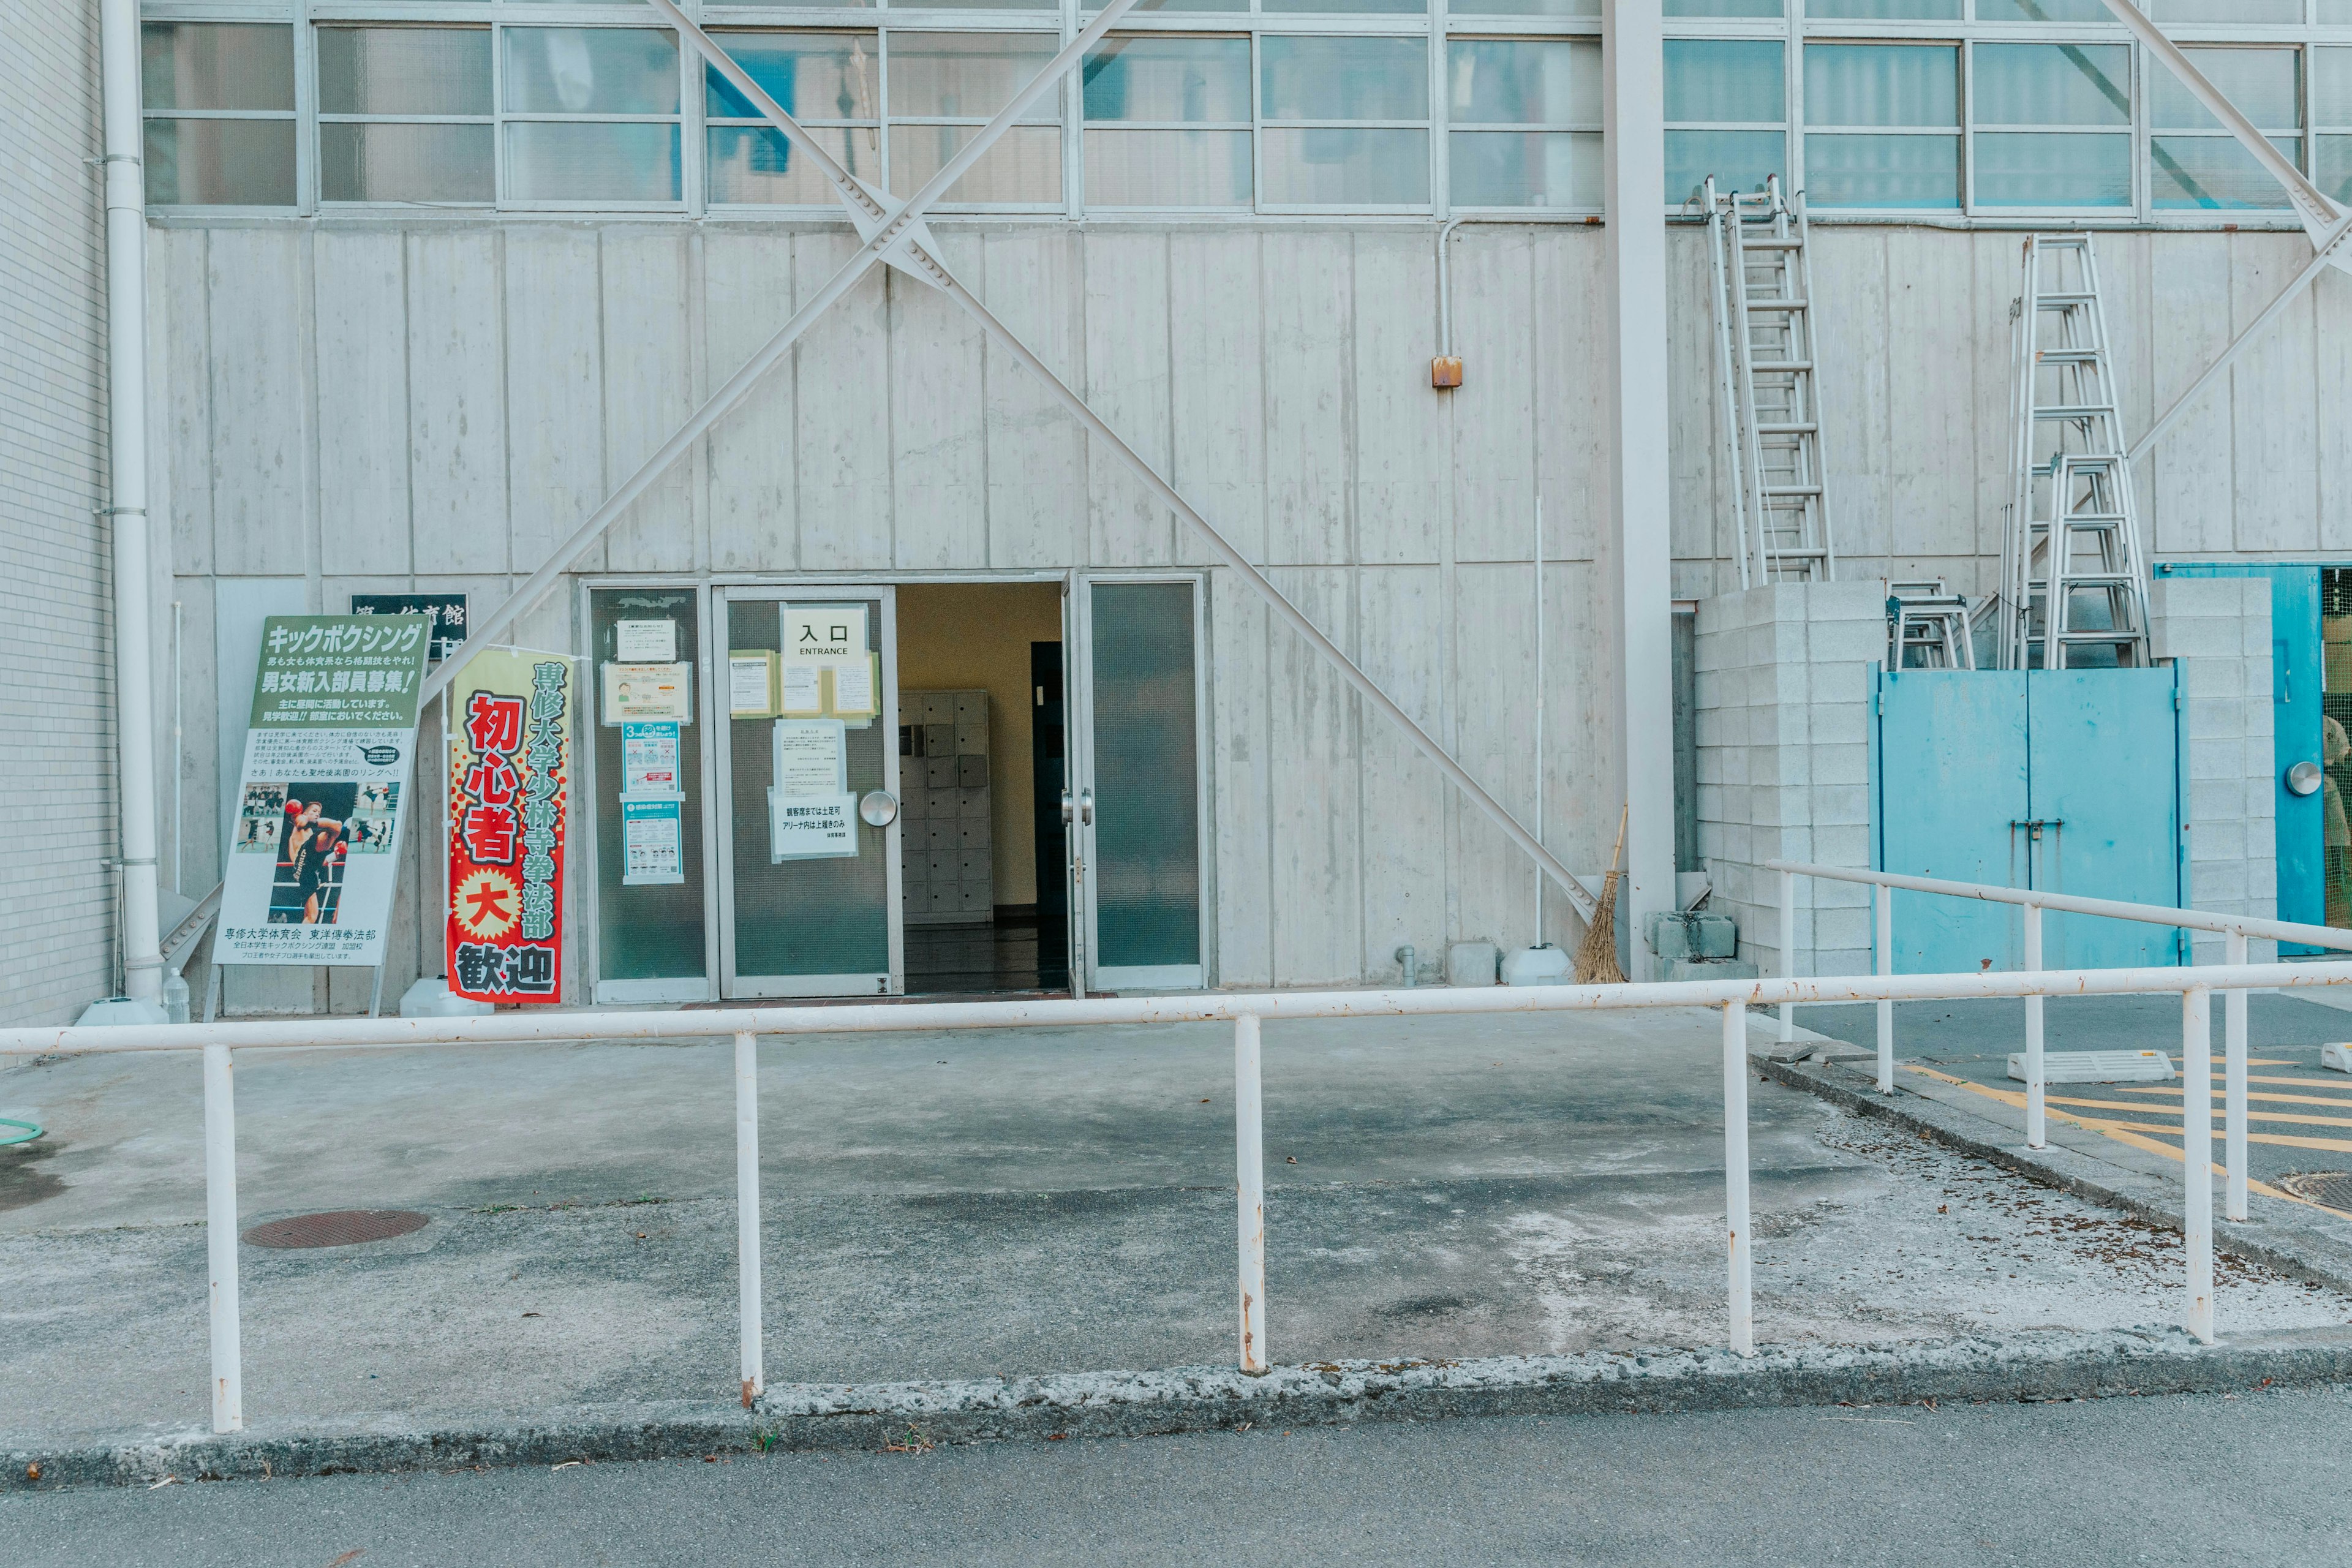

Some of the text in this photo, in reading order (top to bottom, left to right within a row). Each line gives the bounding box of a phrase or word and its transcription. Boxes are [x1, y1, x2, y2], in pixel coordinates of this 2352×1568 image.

[268, 624, 423, 654] キックボクシング
[799, 625, 847, 642] 入口
[262, 670, 415, 694] 男女新入部員募集!
[278, 699, 390, 709] 主に昼間に活動しています。
[466, 694, 522, 861] 初心者
[522, 663, 565, 939] 専修大学少林寺拳法部
[786, 806, 840, 816] 観客席までは土足可
[783, 820, 845, 830] アリーナ内は上履きのみ
[466, 882, 512, 927] 大
[225, 928, 376, 941] 専修大学体育会 東洋傳拳法部
[233, 941, 336, 950] 全日本学生キックボクシング連盟
[456, 943, 555, 993] 歓迎
